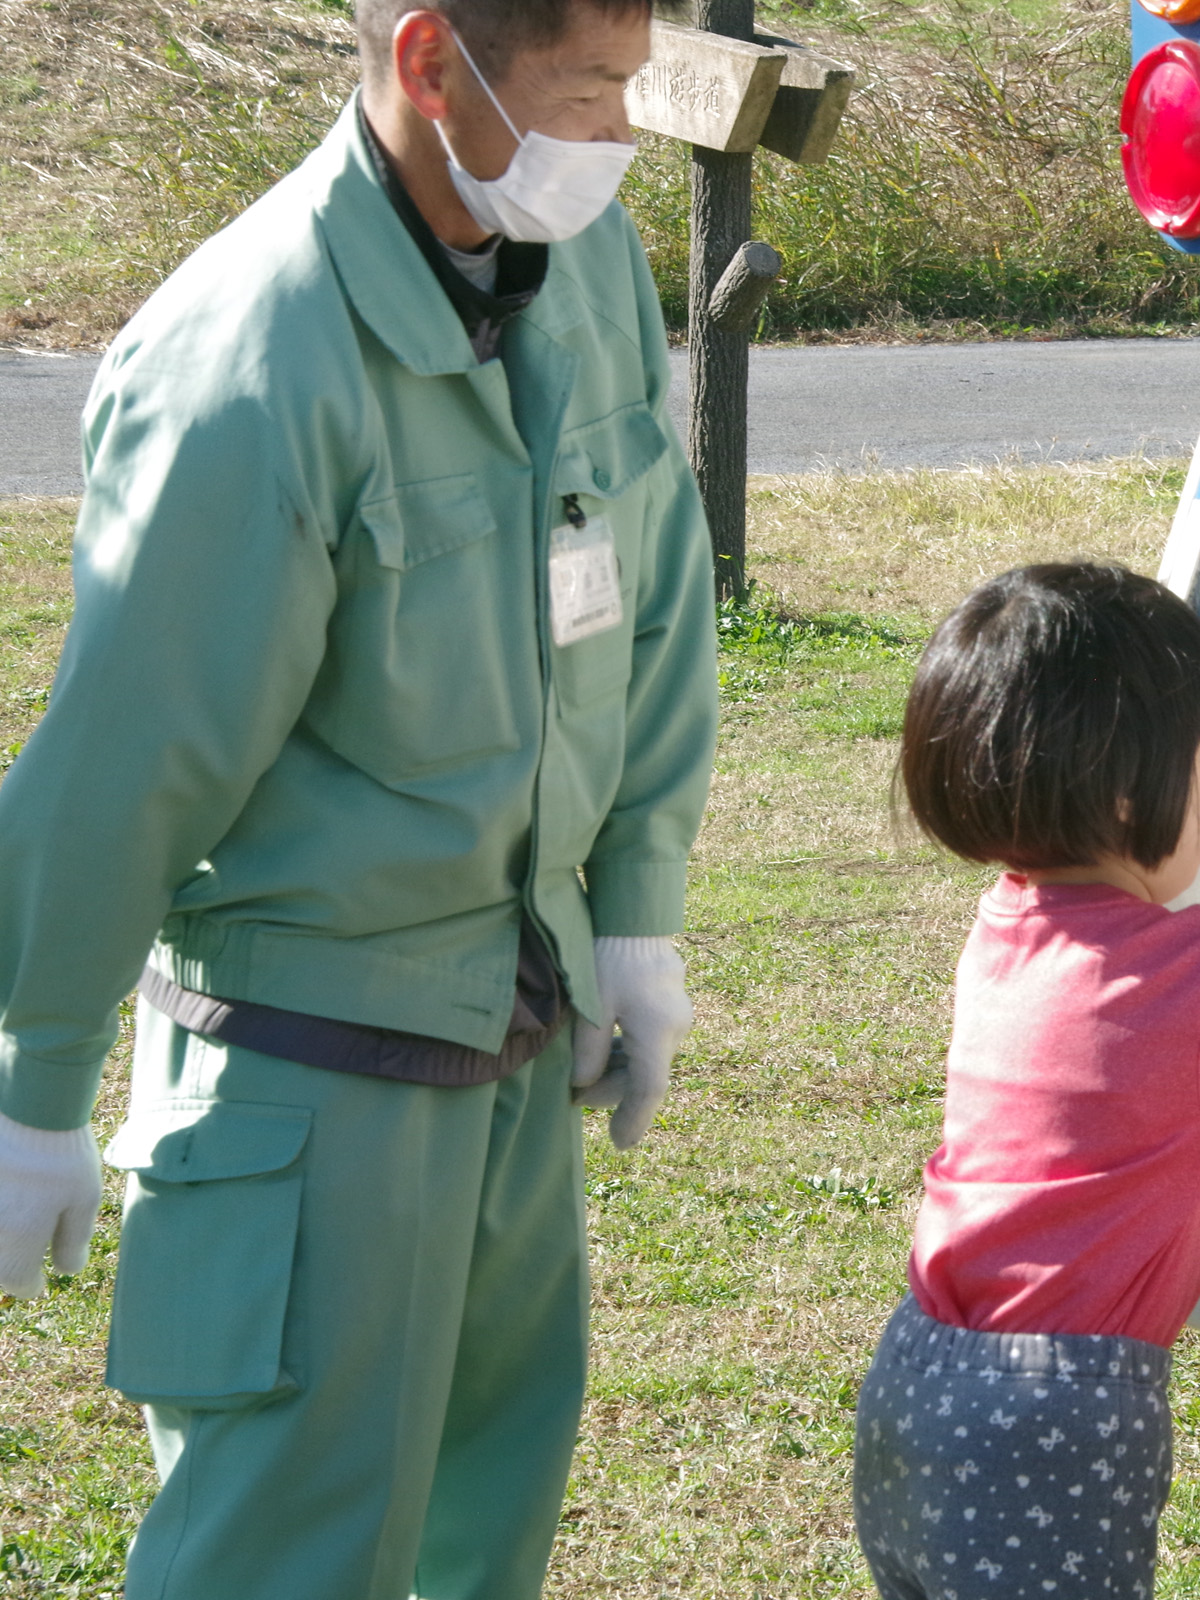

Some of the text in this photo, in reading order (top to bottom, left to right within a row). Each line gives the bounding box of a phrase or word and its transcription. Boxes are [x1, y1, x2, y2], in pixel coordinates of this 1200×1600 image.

[624, 64, 721, 117] 摩川遊歩道
